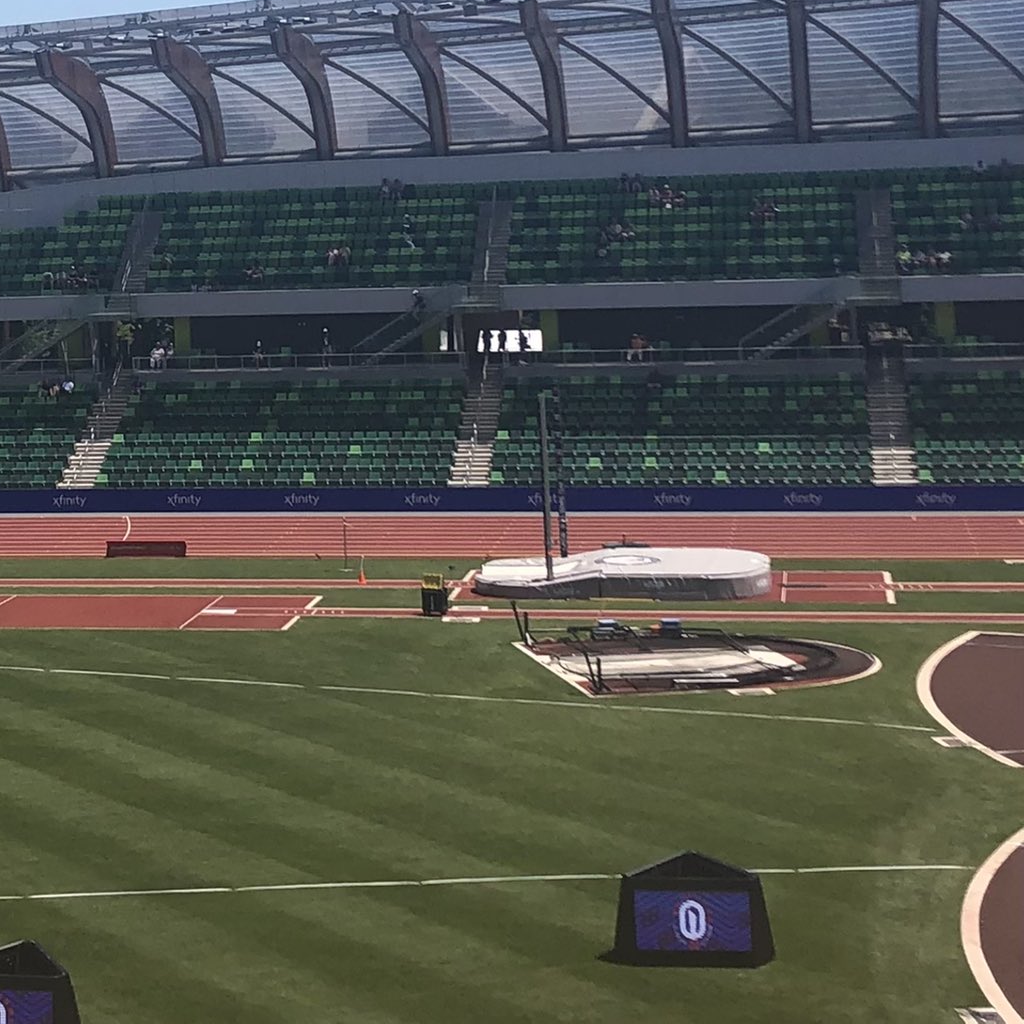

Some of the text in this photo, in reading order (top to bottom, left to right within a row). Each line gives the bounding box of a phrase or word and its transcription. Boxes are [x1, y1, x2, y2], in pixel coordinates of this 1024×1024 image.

[53, 495, 86, 507] xfinity
[168, 494, 201, 506] xfinity
[285, 493, 319, 506] xfinity
[405, 493, 440, 506] xfinity
[654, 492, 691, 506] xfinity
[784, 492, 822, 506] xfinity
